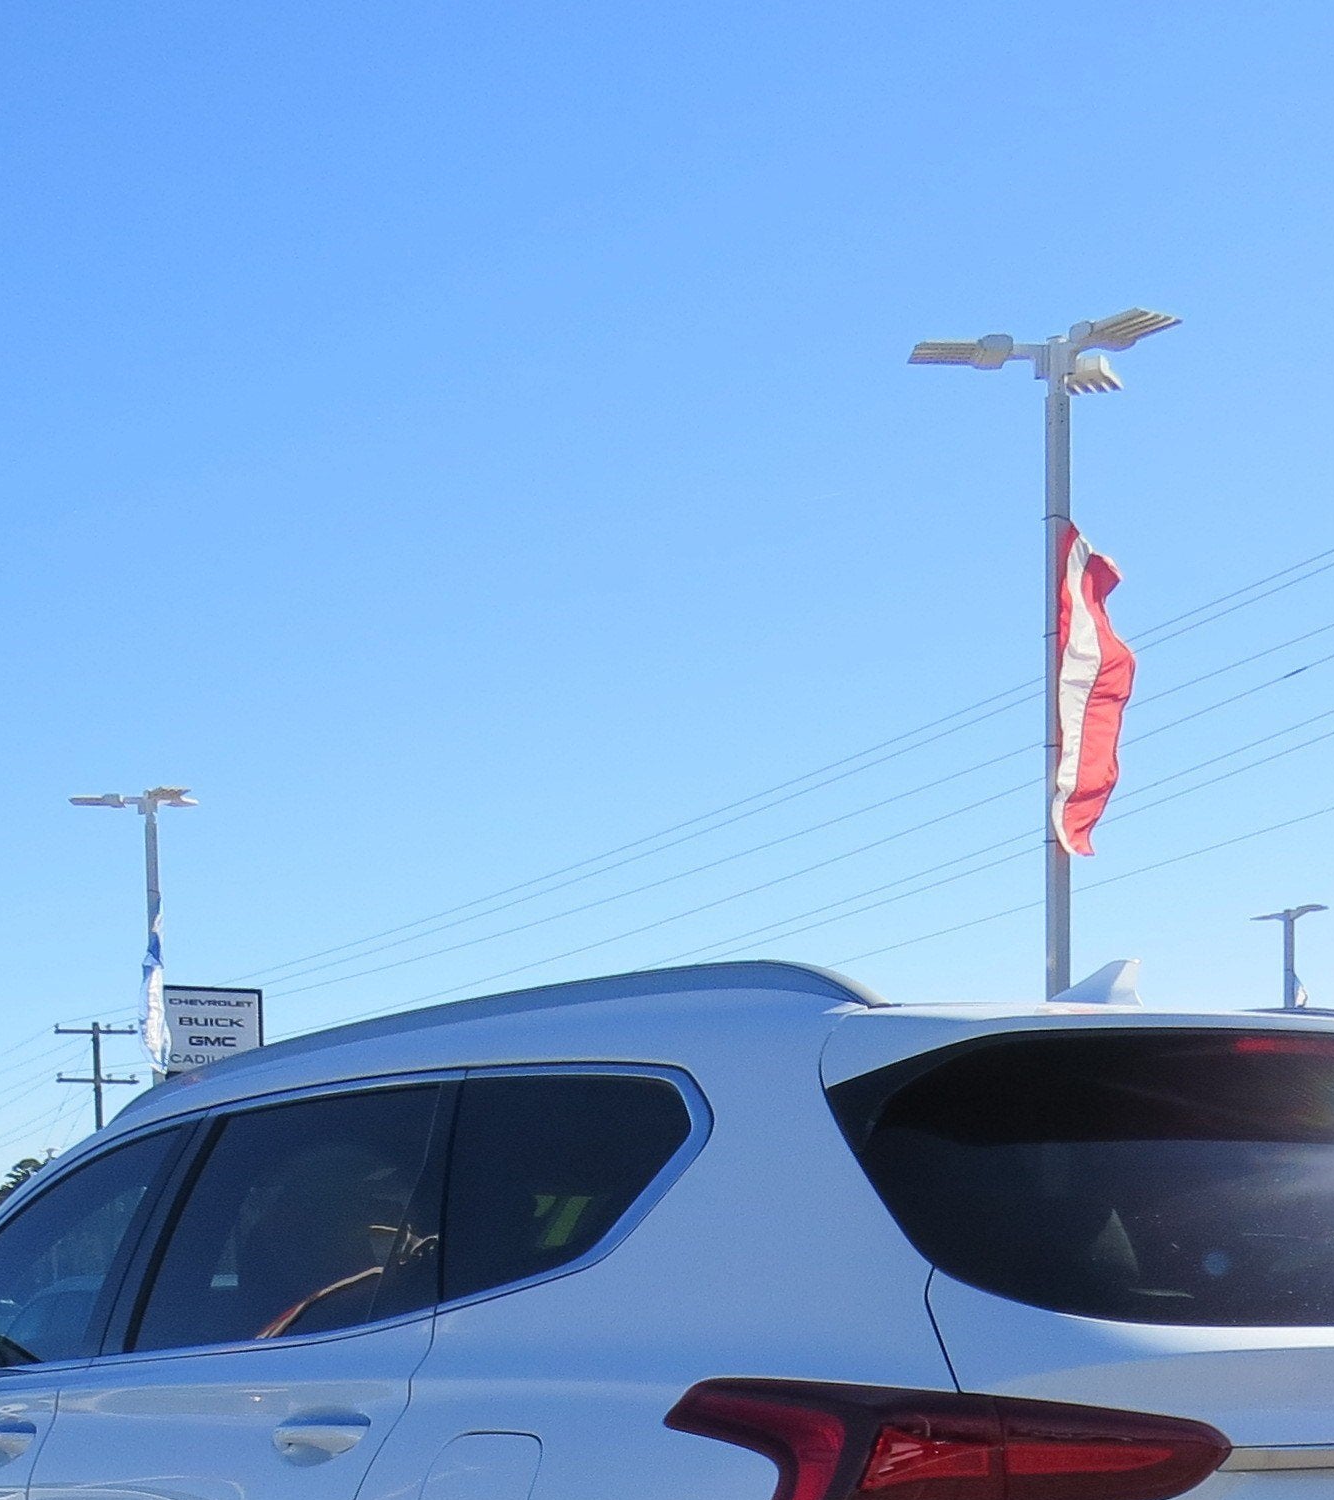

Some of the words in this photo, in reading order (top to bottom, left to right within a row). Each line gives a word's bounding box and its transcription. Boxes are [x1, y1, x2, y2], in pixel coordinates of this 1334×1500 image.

[168, 998, 253, 1008] CHEVROLET
[178, 1016, 244, 1028] BUICK
[188, 1035, 237, 1047] GMC
